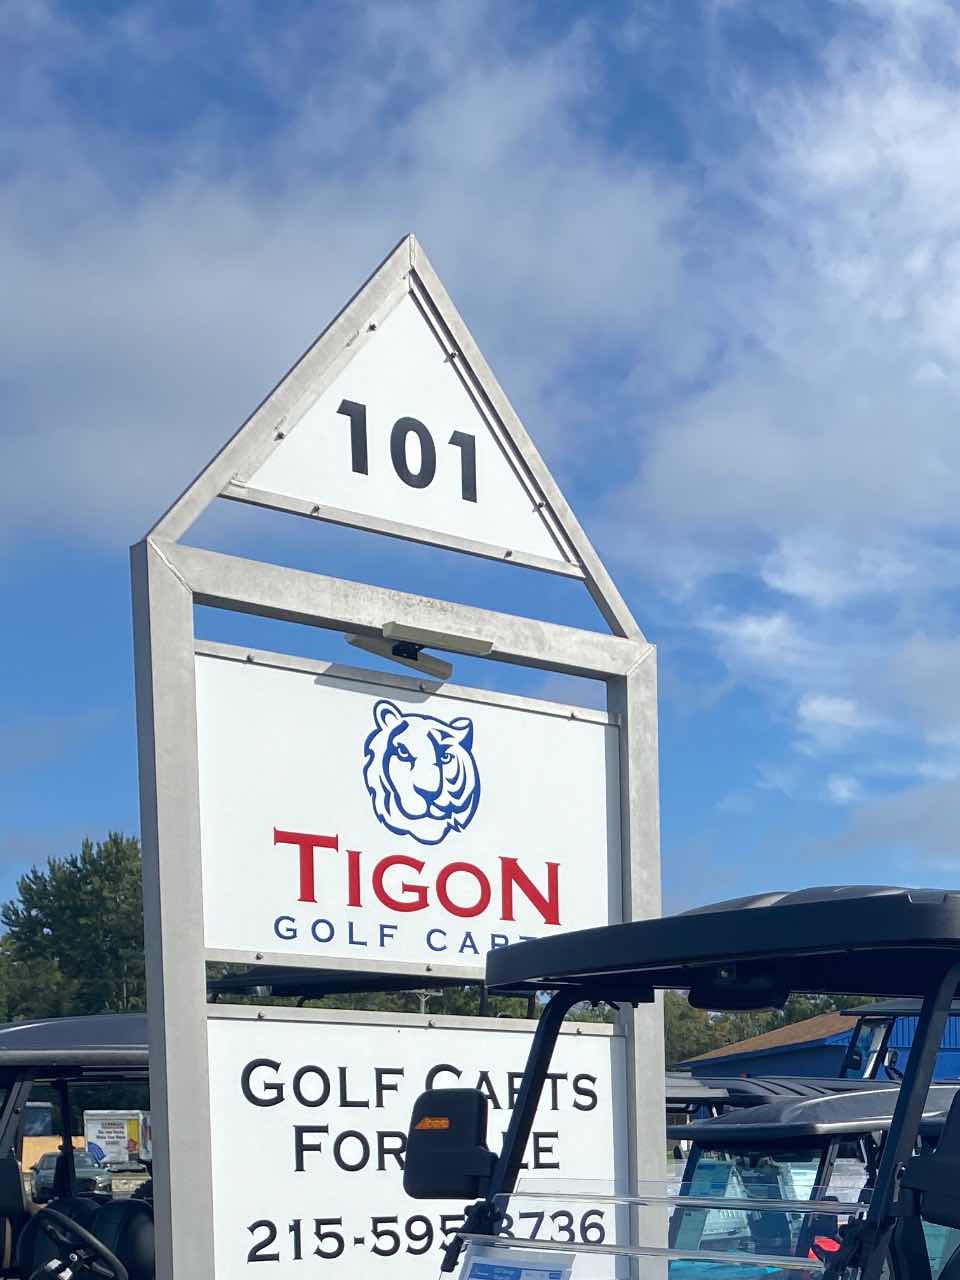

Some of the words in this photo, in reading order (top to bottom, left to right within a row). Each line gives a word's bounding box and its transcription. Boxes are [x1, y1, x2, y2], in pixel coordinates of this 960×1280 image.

[336, 399, 478, 504] 101
[273, 827, 561, 926] TIGON
[273, 915, 398, 949] GOLF
[426, 927, 538, 955] CAR
[240, 1057, 405, 1109] GOLF
[292, 1123, 408, 1172] FOR
[246, 1208, 606, 1263] 215-5958736
